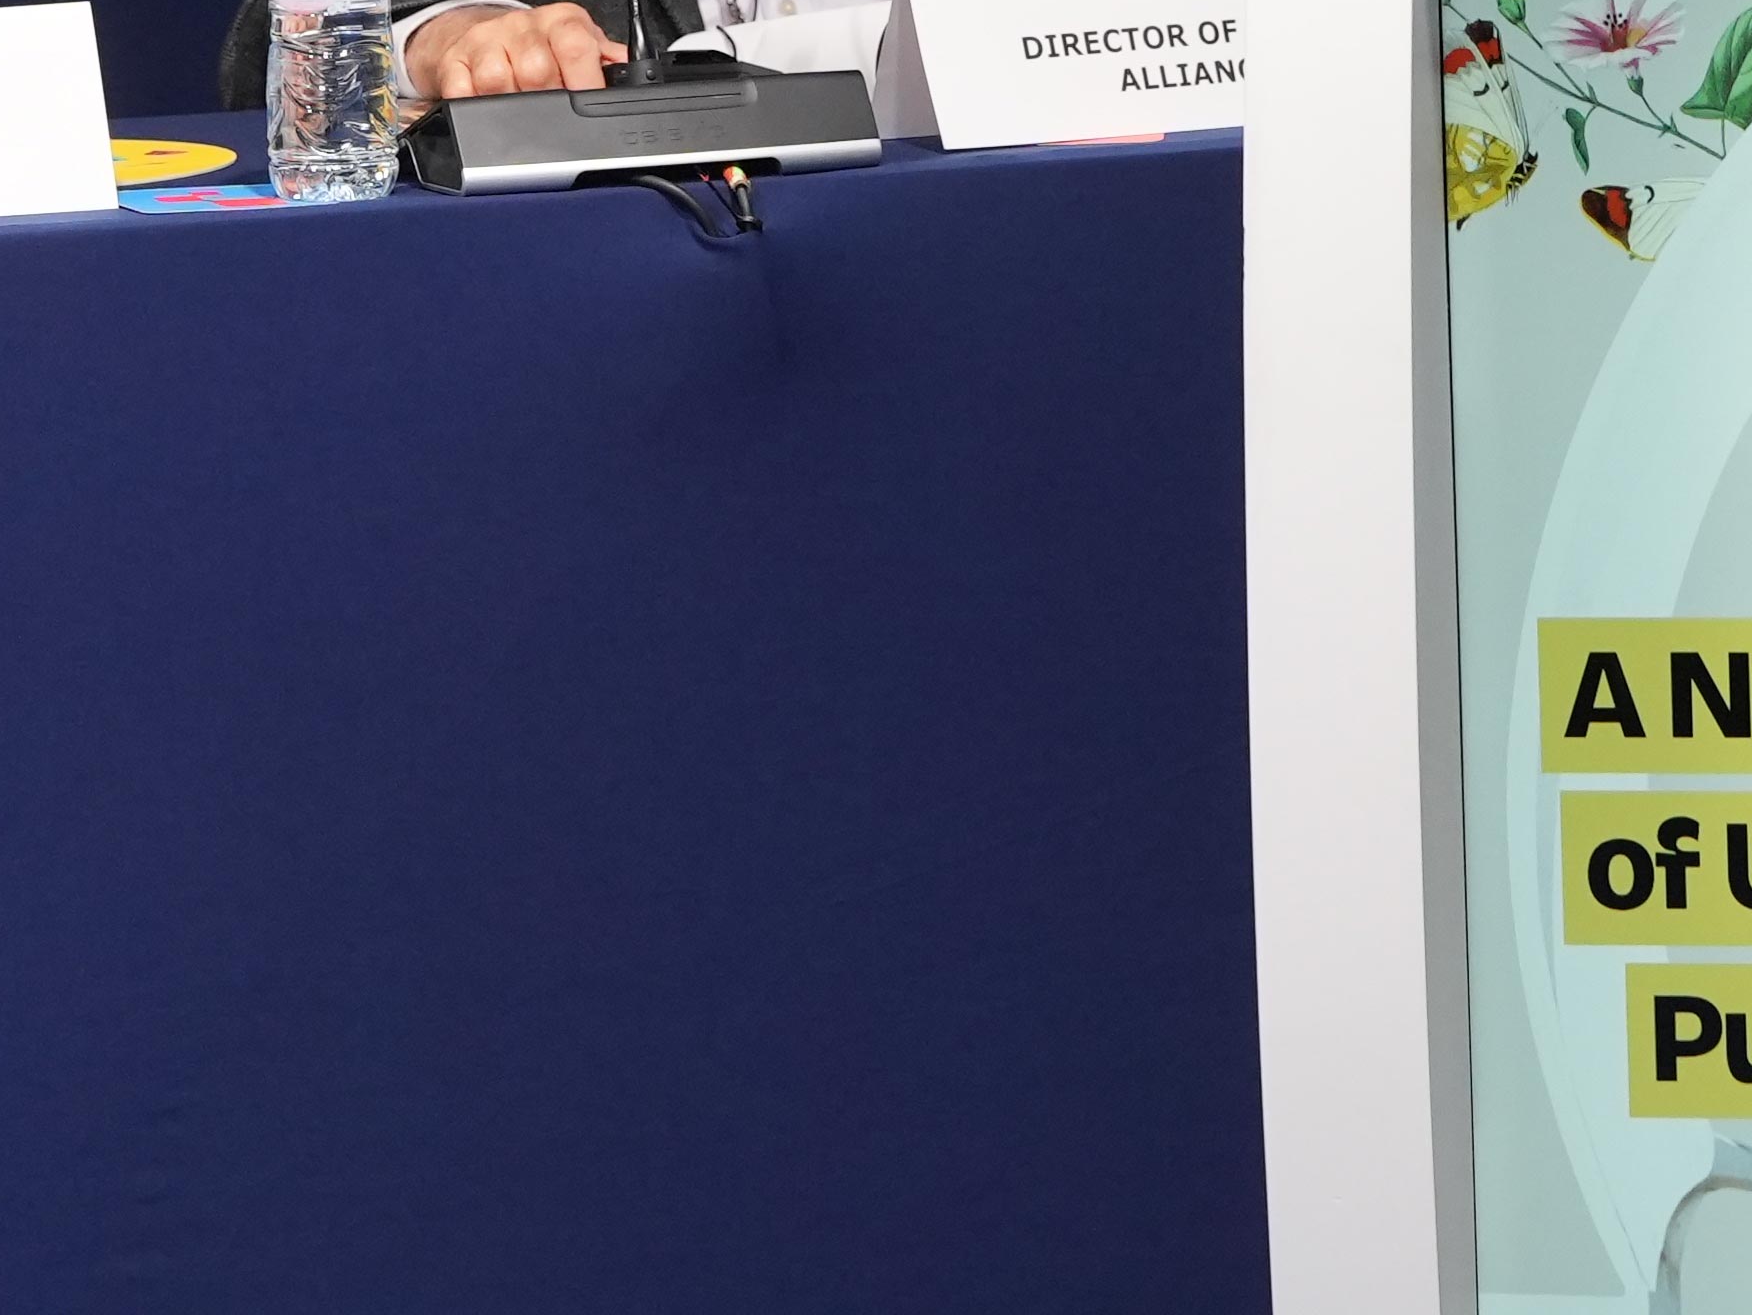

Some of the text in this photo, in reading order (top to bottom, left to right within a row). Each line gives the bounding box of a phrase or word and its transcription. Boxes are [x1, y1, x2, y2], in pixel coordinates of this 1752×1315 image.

[1021, 19, 1237, 60] DIRECTOR OF
[1563, 651, 1647, 740] A
[1586, 816, 1701, 911] of
